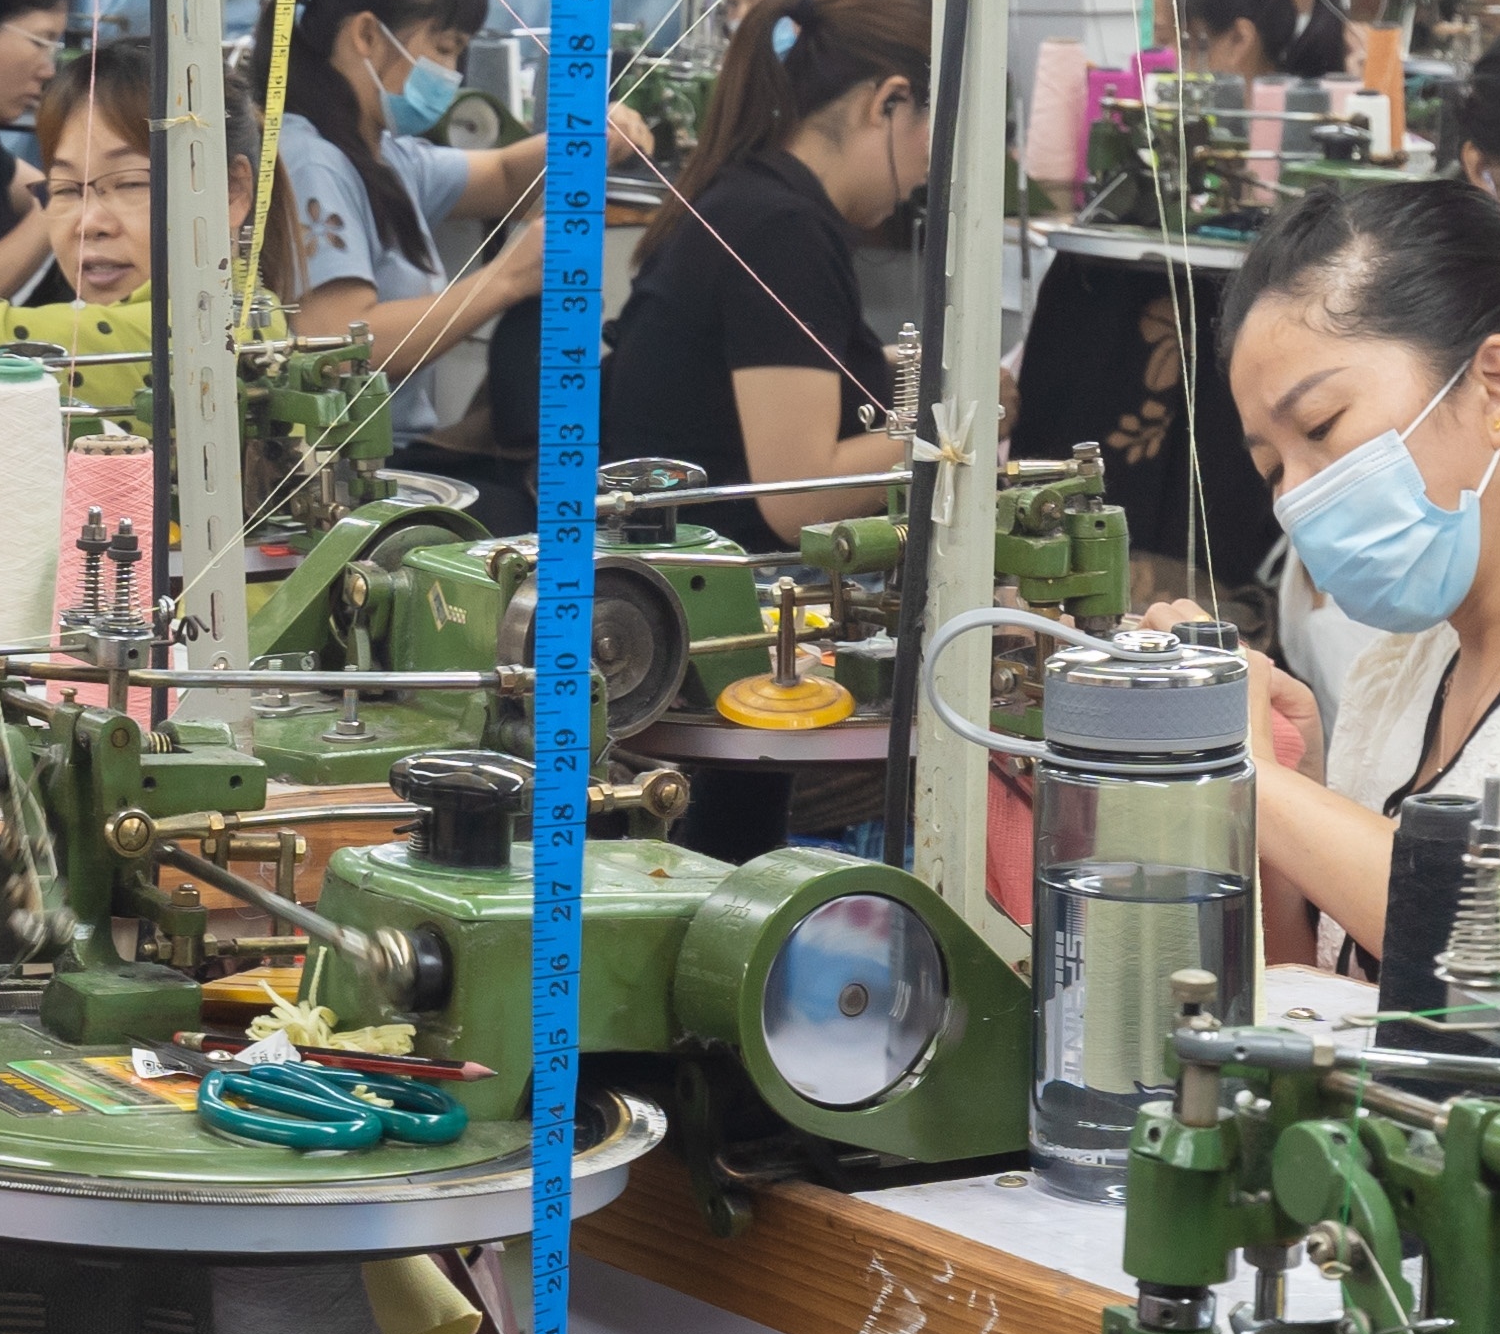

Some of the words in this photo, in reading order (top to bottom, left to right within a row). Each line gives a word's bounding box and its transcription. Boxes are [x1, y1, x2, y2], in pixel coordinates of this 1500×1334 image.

[568, 34, 594, 79] 38
[566, 113, 592, 158] 37
[565, 190, 591, 236] 36
[563, 270, 589, 313] 35
[560, 347, 587, 390] 34
[559, 423, 585, 467] 33
[557, 500, 583, 544] 32
[555, 578, 581, 620] 31
[554, 653, 579, 696] 30
[554, 728, 577, 772] 29
[551, 803, 575, 846] 28
[550, 880, 573, 921] 27
[549, 953, 570, 996] 26
[549, 1028, 569, 1071] 25
[548, 1103, 567, 1145] 24
[546, 1176, 564, 1218] 23
[546, 1249, 563, 1293] 22
